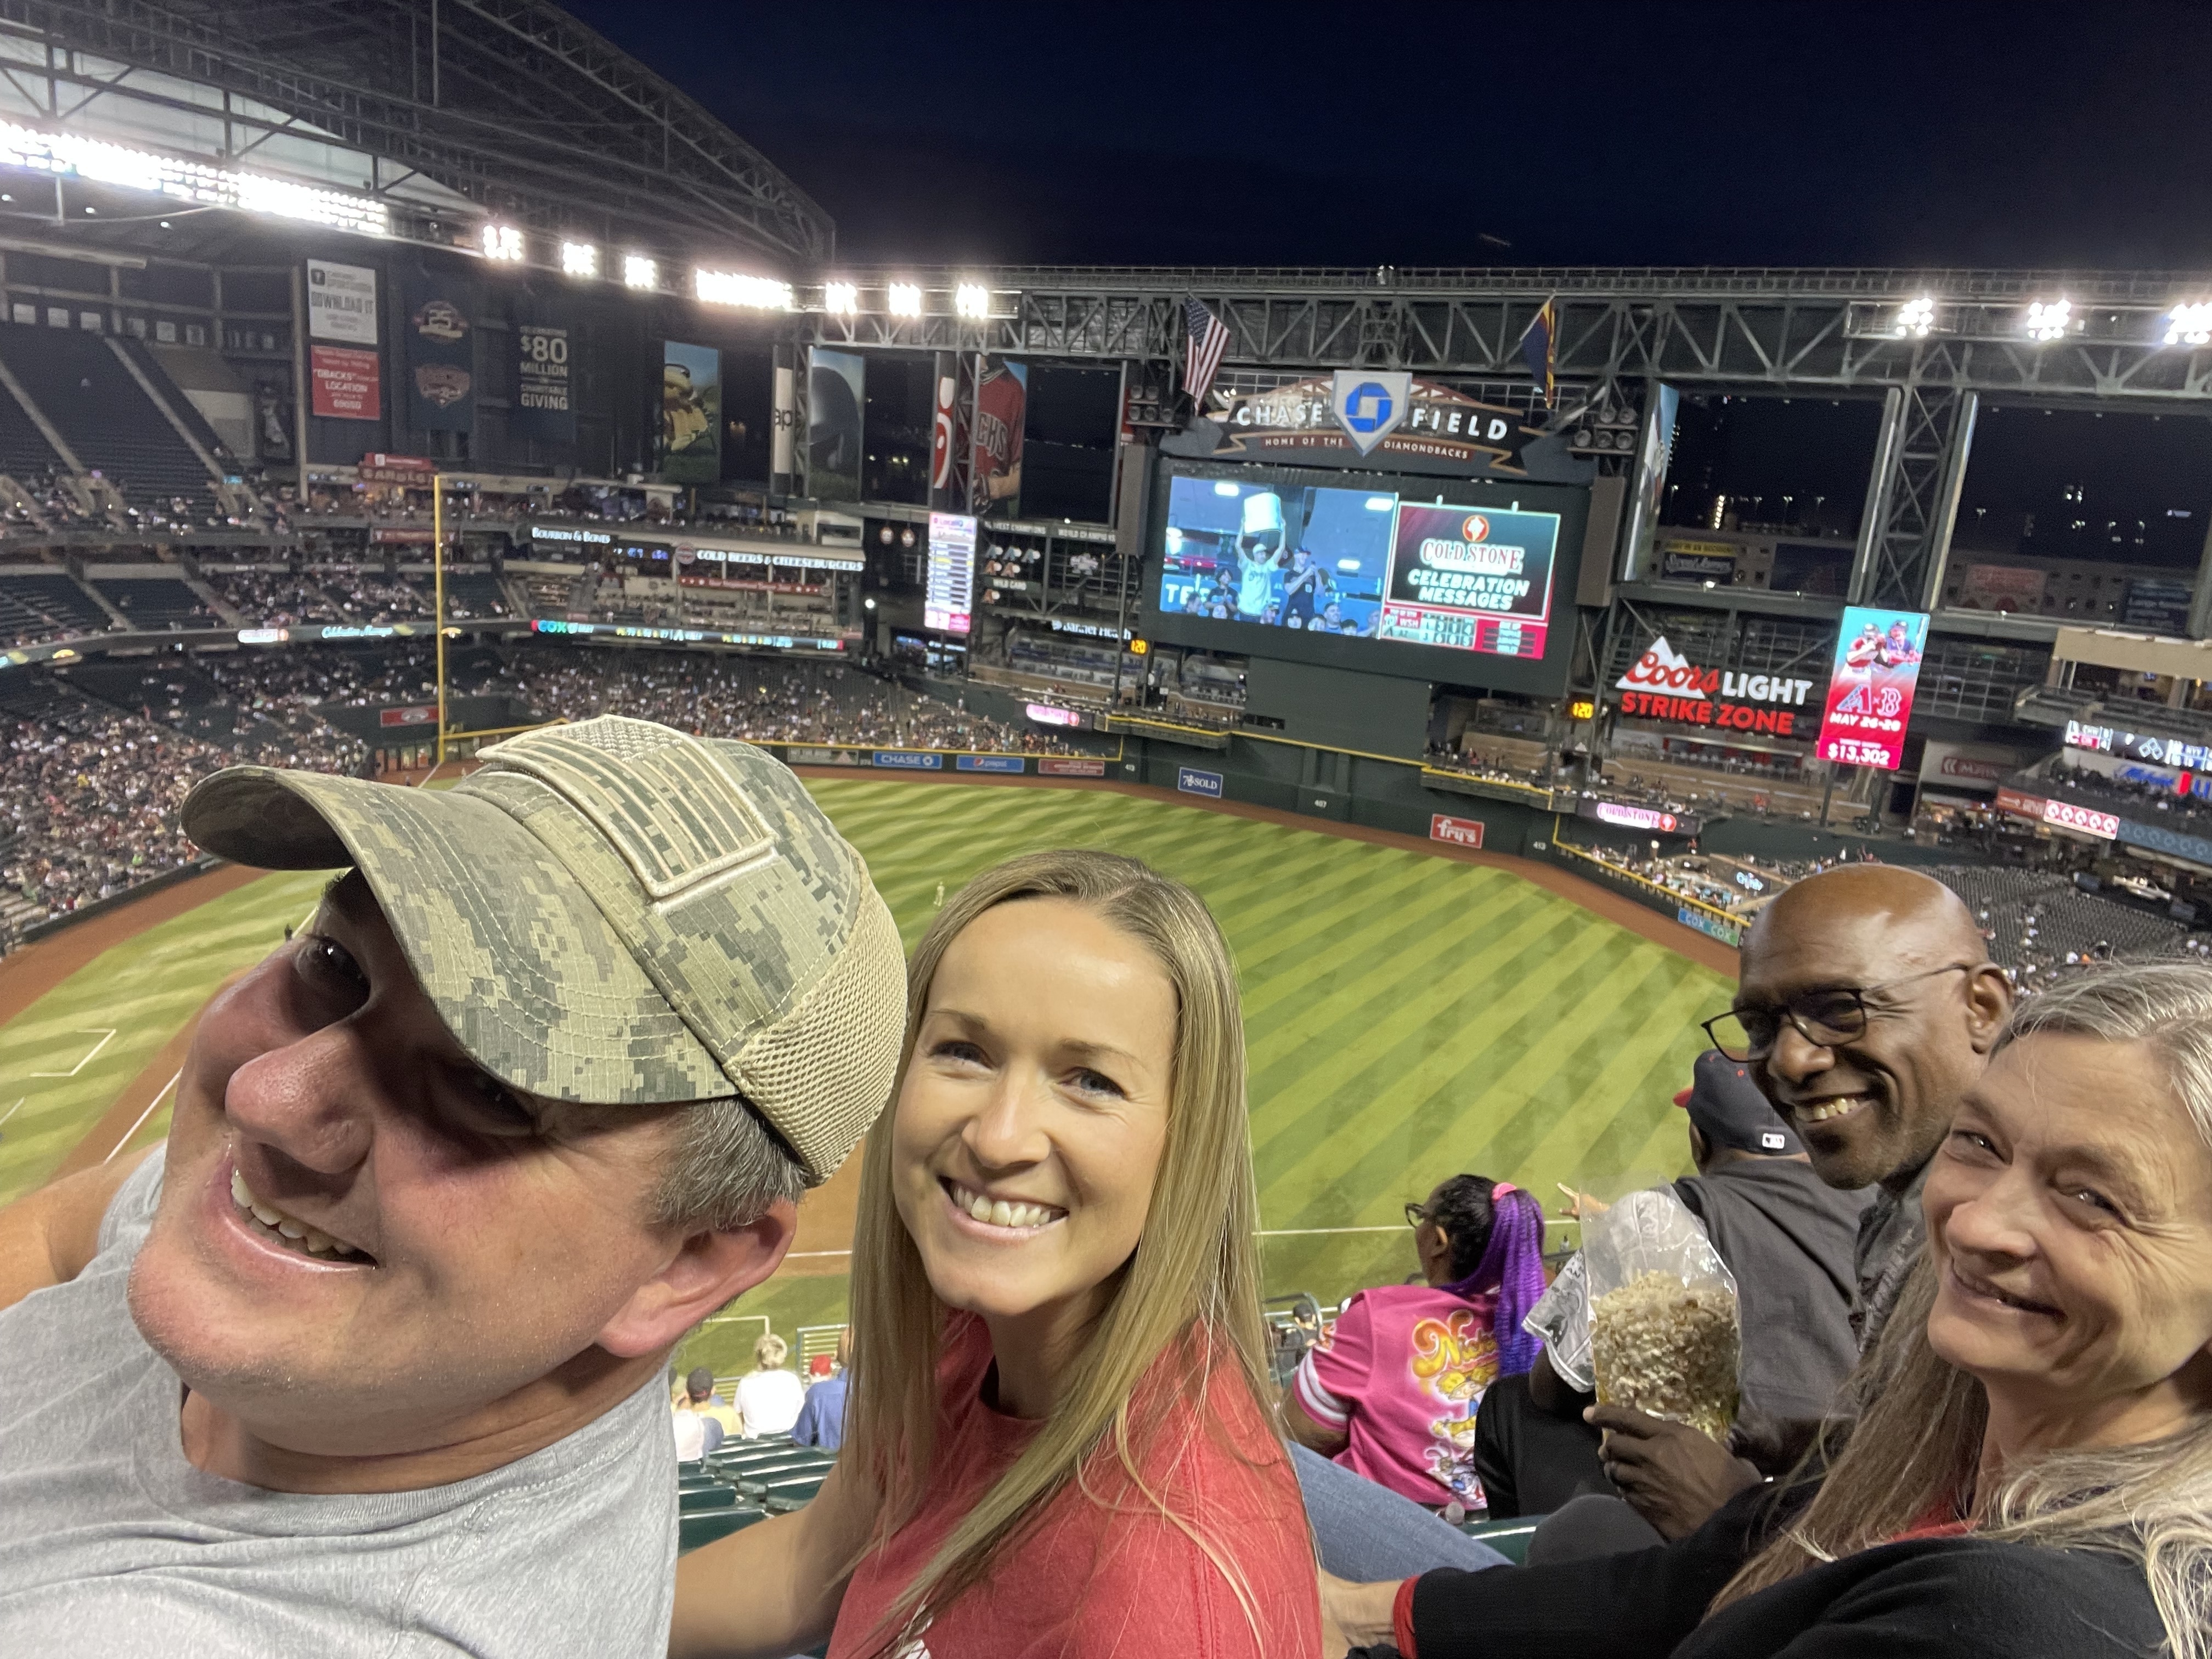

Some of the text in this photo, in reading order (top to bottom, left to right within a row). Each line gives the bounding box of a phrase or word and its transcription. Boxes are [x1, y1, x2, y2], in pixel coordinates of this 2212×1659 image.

[521, 335, 568, 364] $80
[521, 393, 568, 410] GIVING
[1236, 403, 1508, 441] CHASE FIELD
[1265, 437, 1469, 460] HOME OF THE DIAMONDBACKS
[697, 550, 726, 561] COLD
[728, 552, 764, 565] BEERS
[1423, 541, 1522, 570] COLD STONE
[1408, 568, 1530, 597] CELEBRATION
[1418, 586, 1514, 611] MESSAGES
[1400, 618, 1419, 629] WSH
[1131, 639, 1147, 654] 120
[1625, 651, 1813, 706] Coors LIGHT
[1572, 702, 1594, 719] 120
[1621, 691, 1796, 735] STRIKE ZONE
[1829, 712, 1860, 726] MAY
[880, 754, 921, 765] CHASE
[1827, 742, 1891, 766] $13,302
[1686, 913, 1730, 940] COX COX
